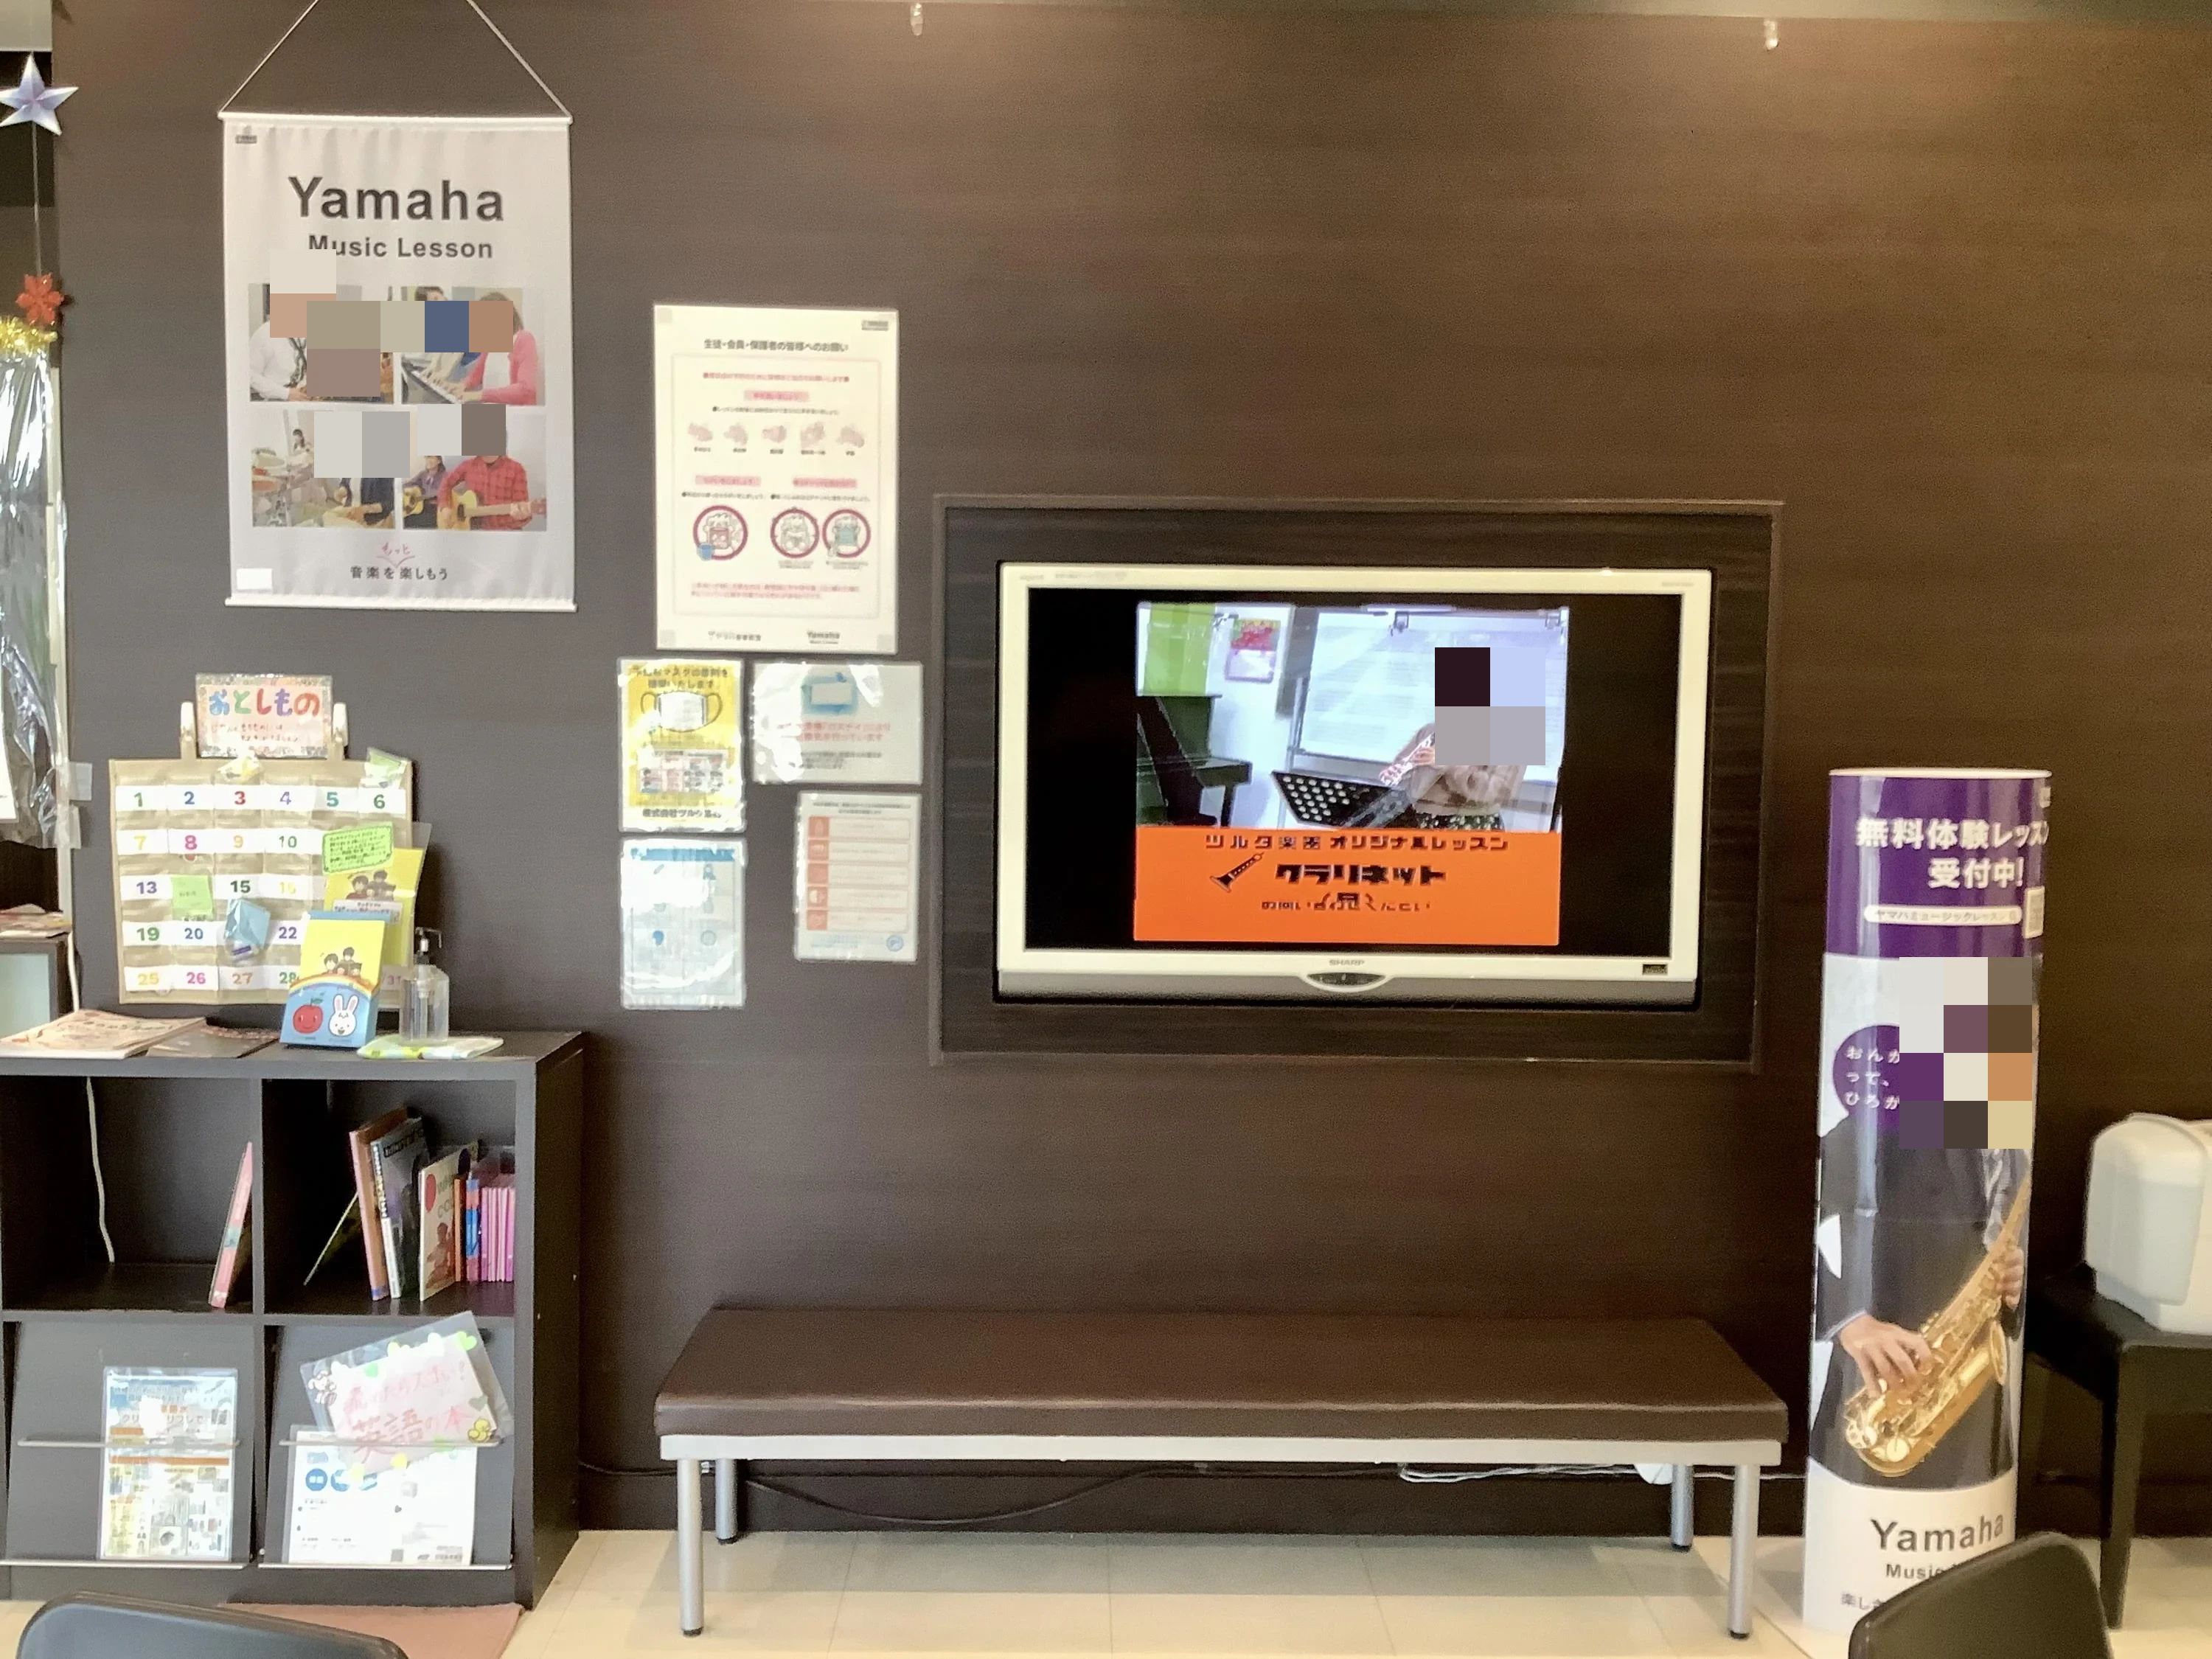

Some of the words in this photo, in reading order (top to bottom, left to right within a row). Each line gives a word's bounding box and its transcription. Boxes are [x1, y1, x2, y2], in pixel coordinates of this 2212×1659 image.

[288, 176, 504, 221] Yamaha
[308, 234, 388, 257] Music
[397, 237, 493, 258] Lesson
[380, 540, 411, 556] もっと
[350, 565, 448, 580] 音楽を楽しもう
[209, 688, 320, 717] おとしもの
[134, 791, 143, 807] 1
[184, 791, 195, 806] 2
[234, 791, 246, 805] 3
[280, 791, 291, 805] 4
[327, 792, 339, 807] 5
[373, 793, 385, 809] 6
[134, 835, 146, 850] 7
[184, 835, 198, 849] 8
[233, 835, 243, 849] 9
[279, 835, 297, 849] 10
[1276, 863, 1447, 886] クラリネット
[1927, 857, 2025, 889] 受付中!
[136, 881, 157, 894] 13
[230, 880, 251, 894] 15
[136, 927, 160, 942] 19
[184, 928, 204, 940] 20
[279, 926, 297, 939] 22
[138, 973, 159, 986] 25
[187, 972, 206, 985] 26
[232, 973, 253, 985] 27
[279, 971, 296, 984] 28
[388, 975, 402, 986] 31
[351, 1405, 475, 1464] 英語の本
[1871, 1514, 2003, 1553] Yamaha
